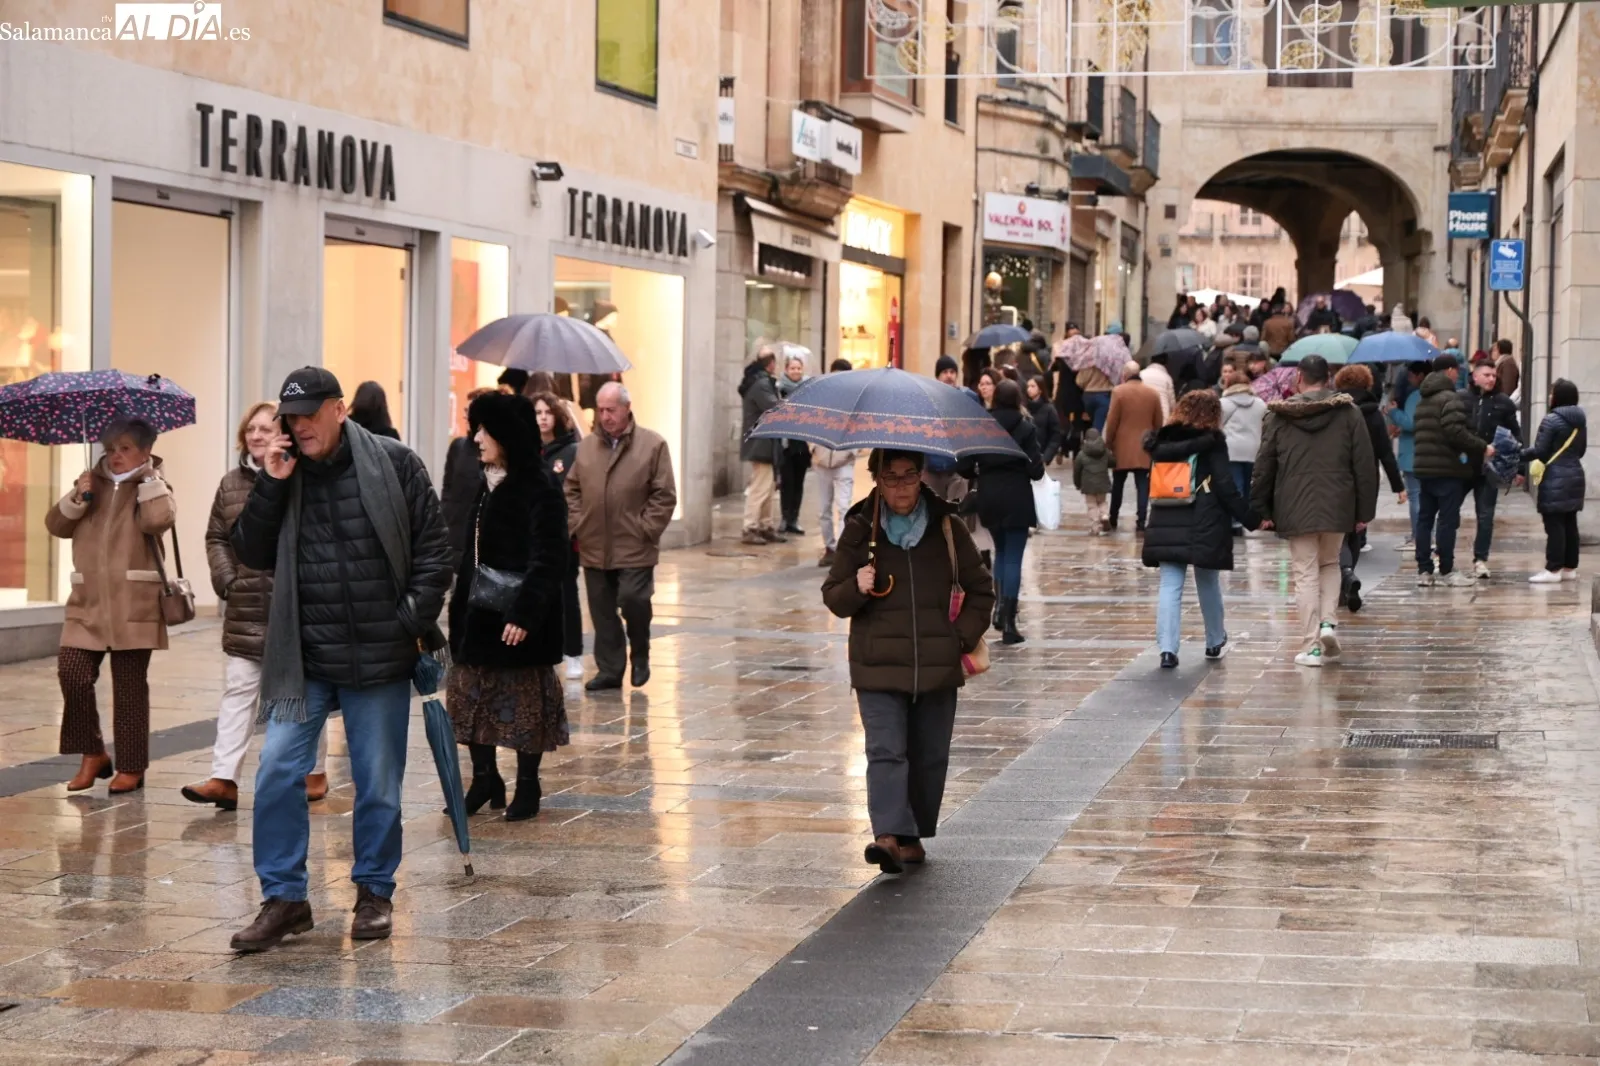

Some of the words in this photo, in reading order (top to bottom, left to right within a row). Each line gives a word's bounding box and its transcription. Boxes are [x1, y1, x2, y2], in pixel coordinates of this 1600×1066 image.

[196, 102, 396, 202] TERRANOVA
[567, 186, 688, 258] TERRANOVA
[988, 213, 1035, 228] VALENTINA
[1449, 210, 1488, 221] Phone
[1449, 220, 1488, 232] House
